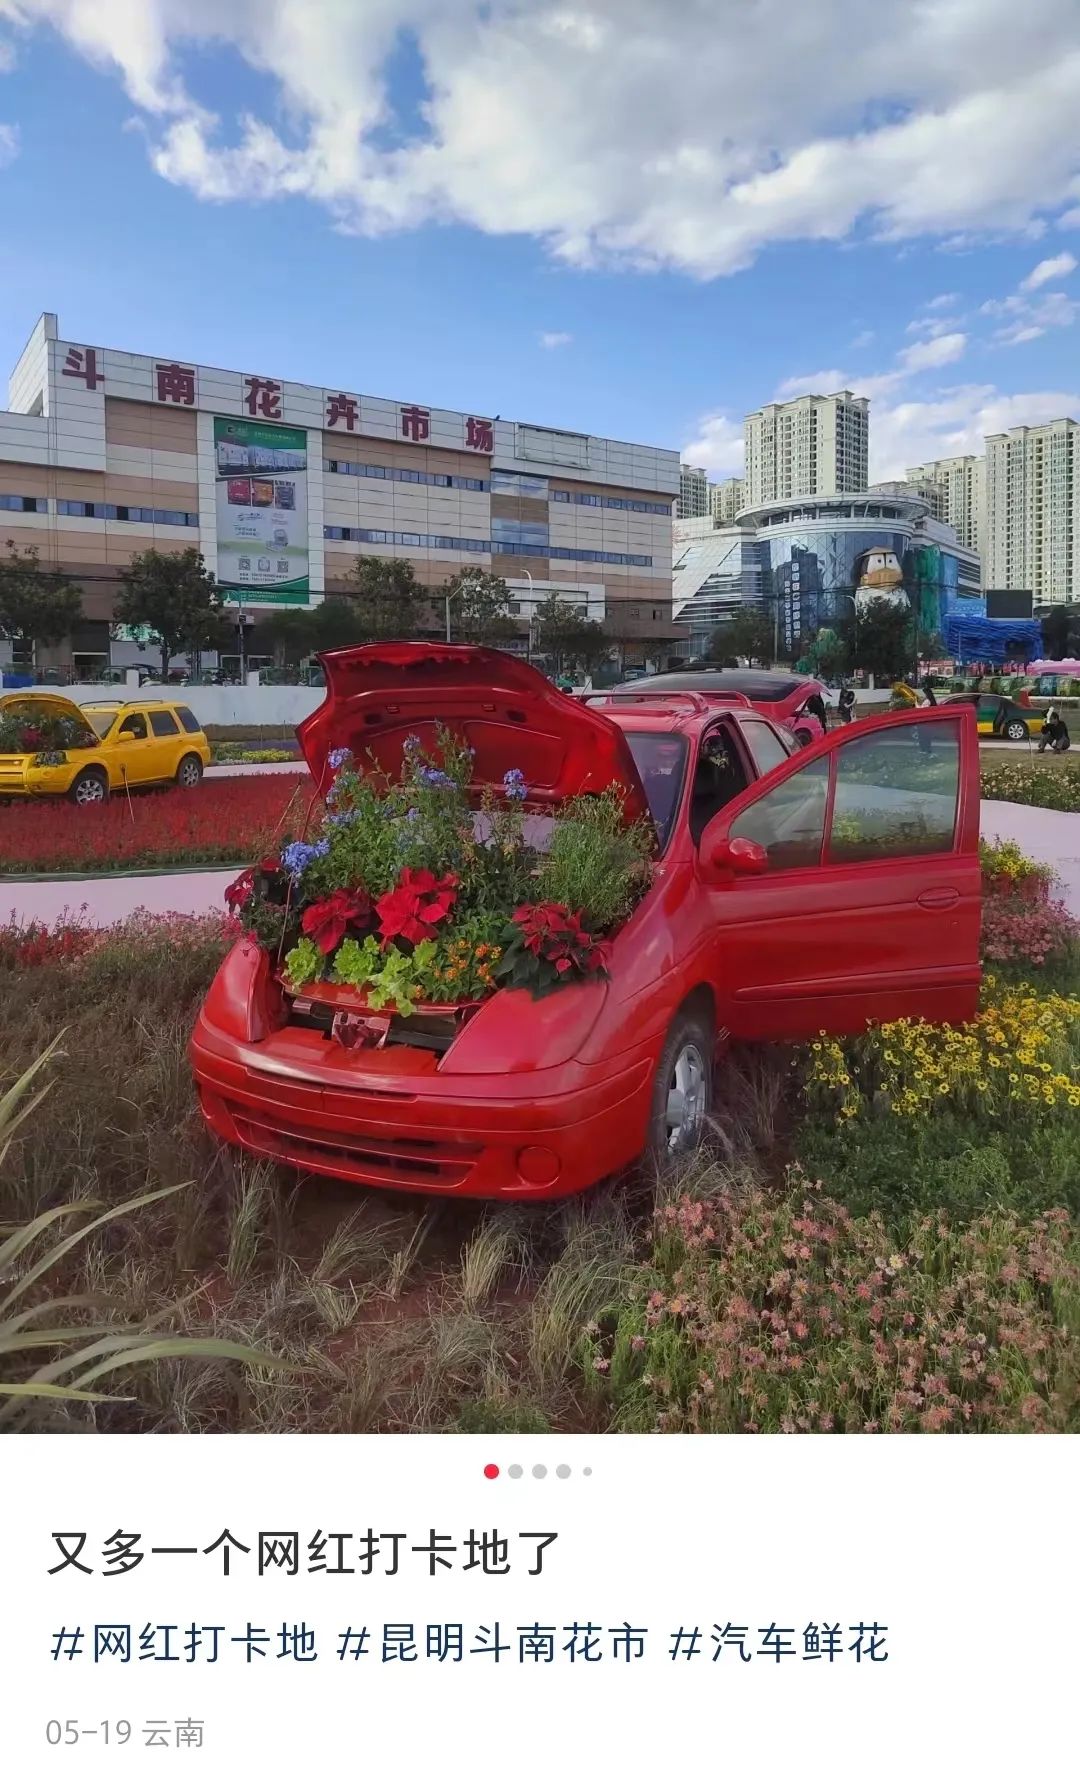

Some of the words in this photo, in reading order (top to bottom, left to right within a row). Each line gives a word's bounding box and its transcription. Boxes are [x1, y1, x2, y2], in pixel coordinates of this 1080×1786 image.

[61, 347, 494, 453] 斗南花卉市场
